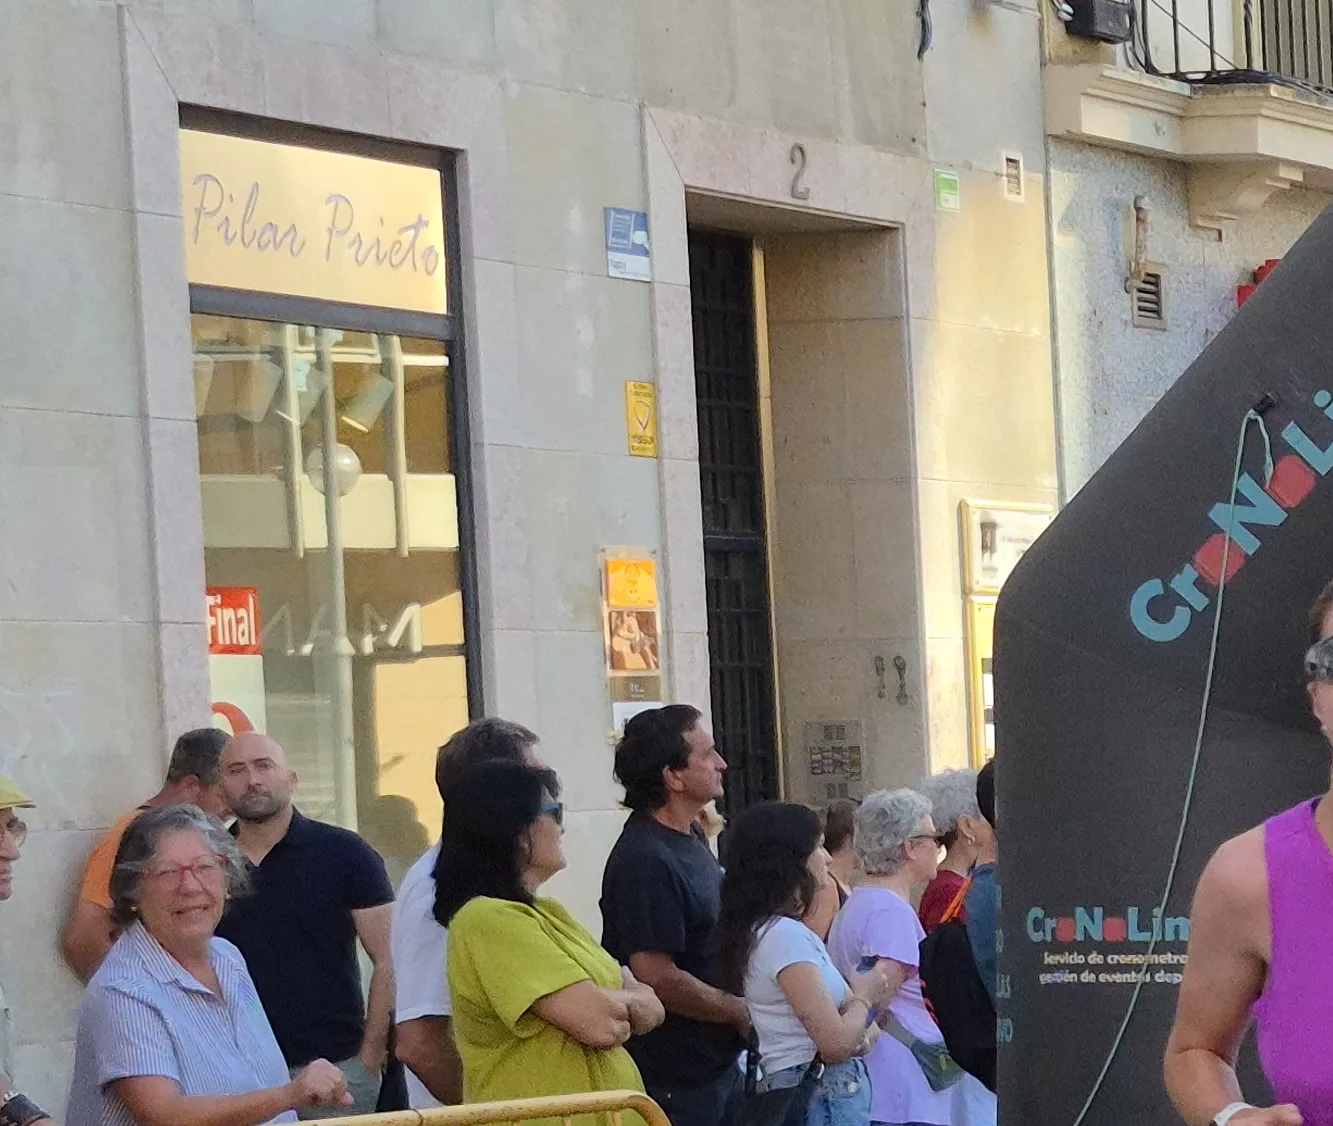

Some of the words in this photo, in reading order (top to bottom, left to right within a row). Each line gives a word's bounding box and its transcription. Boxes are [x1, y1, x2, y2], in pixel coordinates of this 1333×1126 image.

[789, 142, 810, 200] 2
[192, 173, 306, 258] Pilar
[325, 193, 439, 276] Prieto
[1087, 951, 1104, 965] de
[1080, 970, 1096, 983] de
